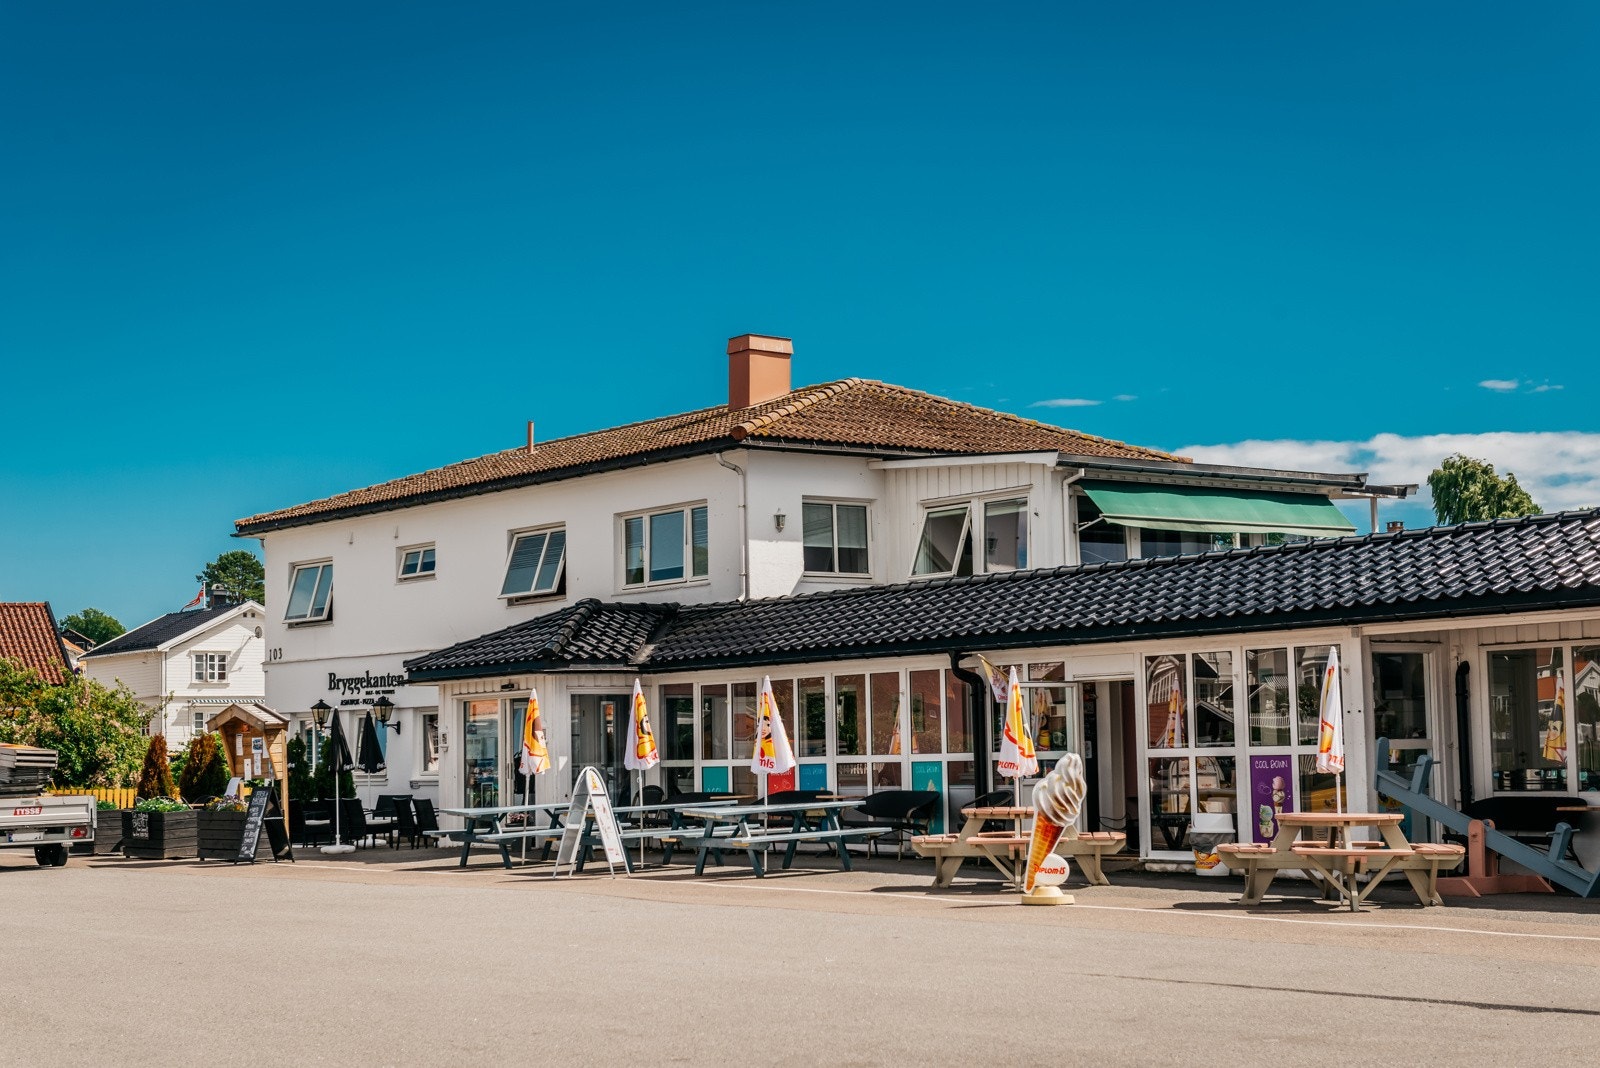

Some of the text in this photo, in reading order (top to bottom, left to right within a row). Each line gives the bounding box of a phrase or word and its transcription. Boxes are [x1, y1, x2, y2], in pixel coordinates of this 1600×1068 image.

[269, 647, 283, 661] 103
[328, 670, 405, 695] Bryggekanten
[1254, 760, 1269, 769] COOL
[15, 807, 42, 815] TYSSE
